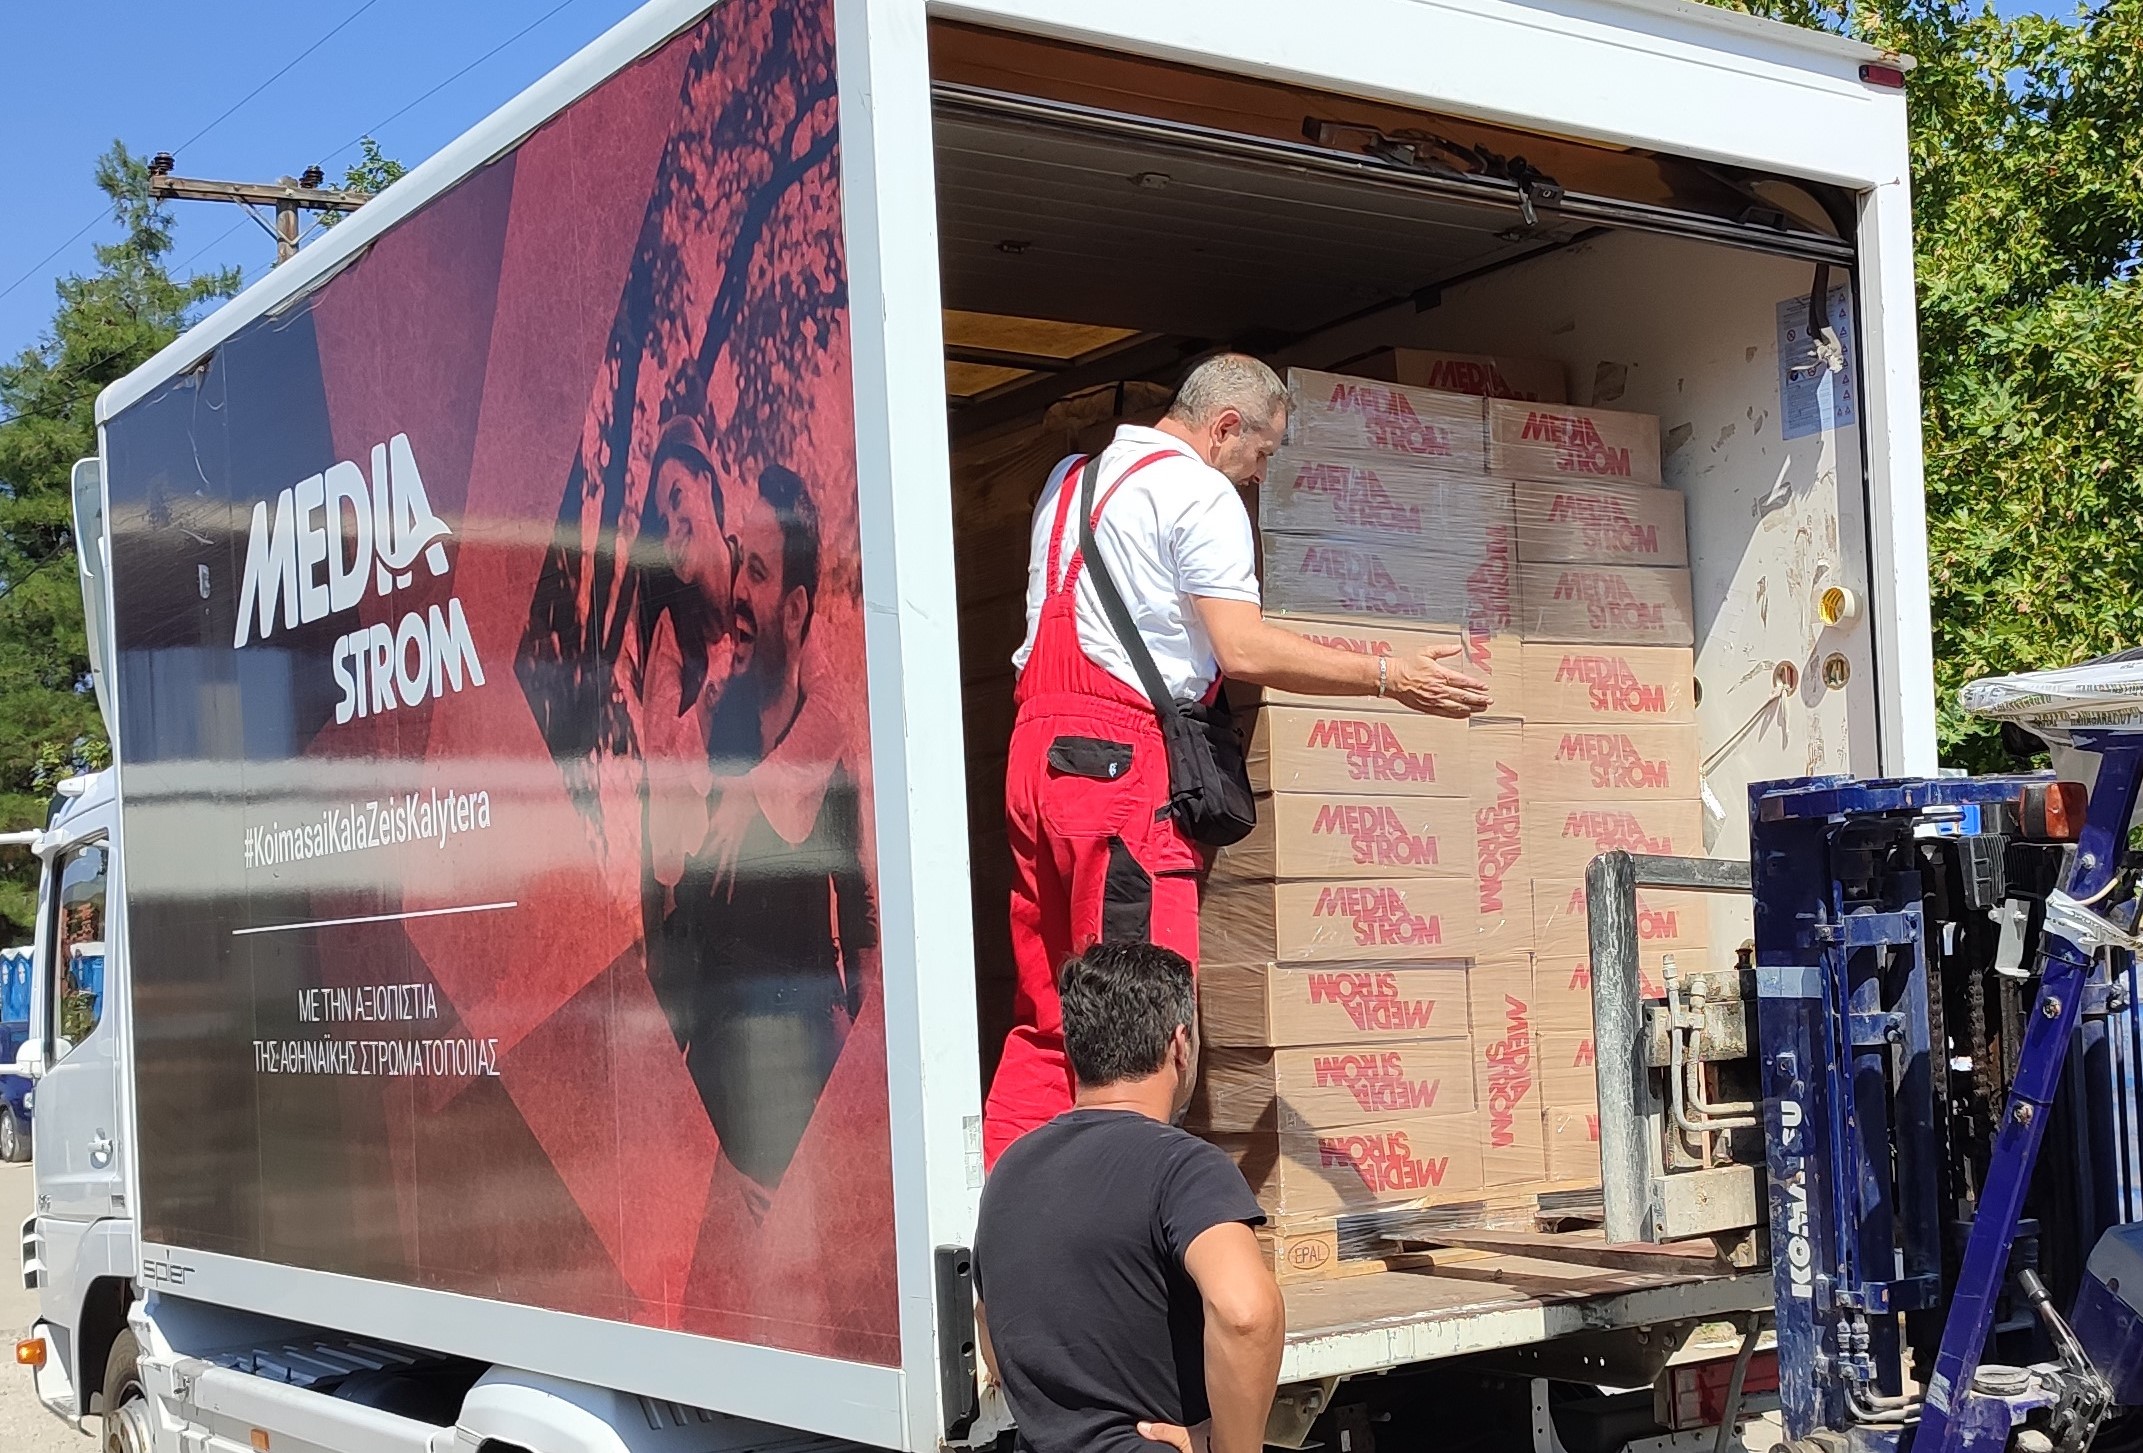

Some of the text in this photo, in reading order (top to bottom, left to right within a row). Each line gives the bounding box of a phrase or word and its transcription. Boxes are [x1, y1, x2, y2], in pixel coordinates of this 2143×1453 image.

[1428, 360, 1518, 397] MEDIA
[1327, 383, 1423, 427] MEDIA
[1366, 417, 1451, 456] STROM
[1521, 411, 1605, 446] MEDIA
[1555, 444, 1631, 477] STROM
[1293, 461, 1393, 505] MEDIA
[1333, 496, 1422, 533] STROM
[1548, 494, 1631, 529] MEDIA
[233, 432, 453, 649] MEDIA
[1584, 524, 1658, 553] STROM
[1300, 545, 1399, 591] MEDIA
[1338, 583, 1427, 616] STROM
[1554, 571, 1632, 604] MEDIA
[1588, 602, 1666, 630] STROM
[332, 597, 486, 725] STROM
[1554, 654, 1642, 686] MEDIA
[1589, 683, 1668, 713] STROM
[1306, 719, 1404, 754] MEDIA
[1554, 733, 1643, 763] MEDIA
[1346, 750, 1437, 783] STROM
[1590, 760, 1670, 789] STROM
[243, 786, 491, 869] #KoimasaiKalaZeisKalytera
[1311, 804, 1406, 840] MEDIA
[1496, 760, 1521, 876] MEDIA
[1562, 811, 1645, 838] MEDIA
[1351, 835, 1440, 866] STROM
[1475, 806, 1504, 914] STROM
[1312, 887, 1412, 920] MEDIA
[1352, 914, 1443, 946] STROM
[354, 983, 438, 1021] ΑΞΙΟΠΙΣΤΙΑ
[1307, 971, 1398, 1004] STROM
[1342, 999, 1436, 1031] MEDIA
[1505, 994, 1532, 1109] MEDIA
[1313, 1051, 1404, 1088] STROM
[1347, 1079, 1440, 1113] MEDIA
[1485, 1041, 1515, 1148] STROM
[1319, 1130, 1411, 1168] STROM
[1352, 1156, 1449, 1193] MEDIA
[1780, 1100, 1813, 1299] KOMASU
[144, 1249, 195, 1287] spier
[1294, 1246, 1325, 1265] EPAL
